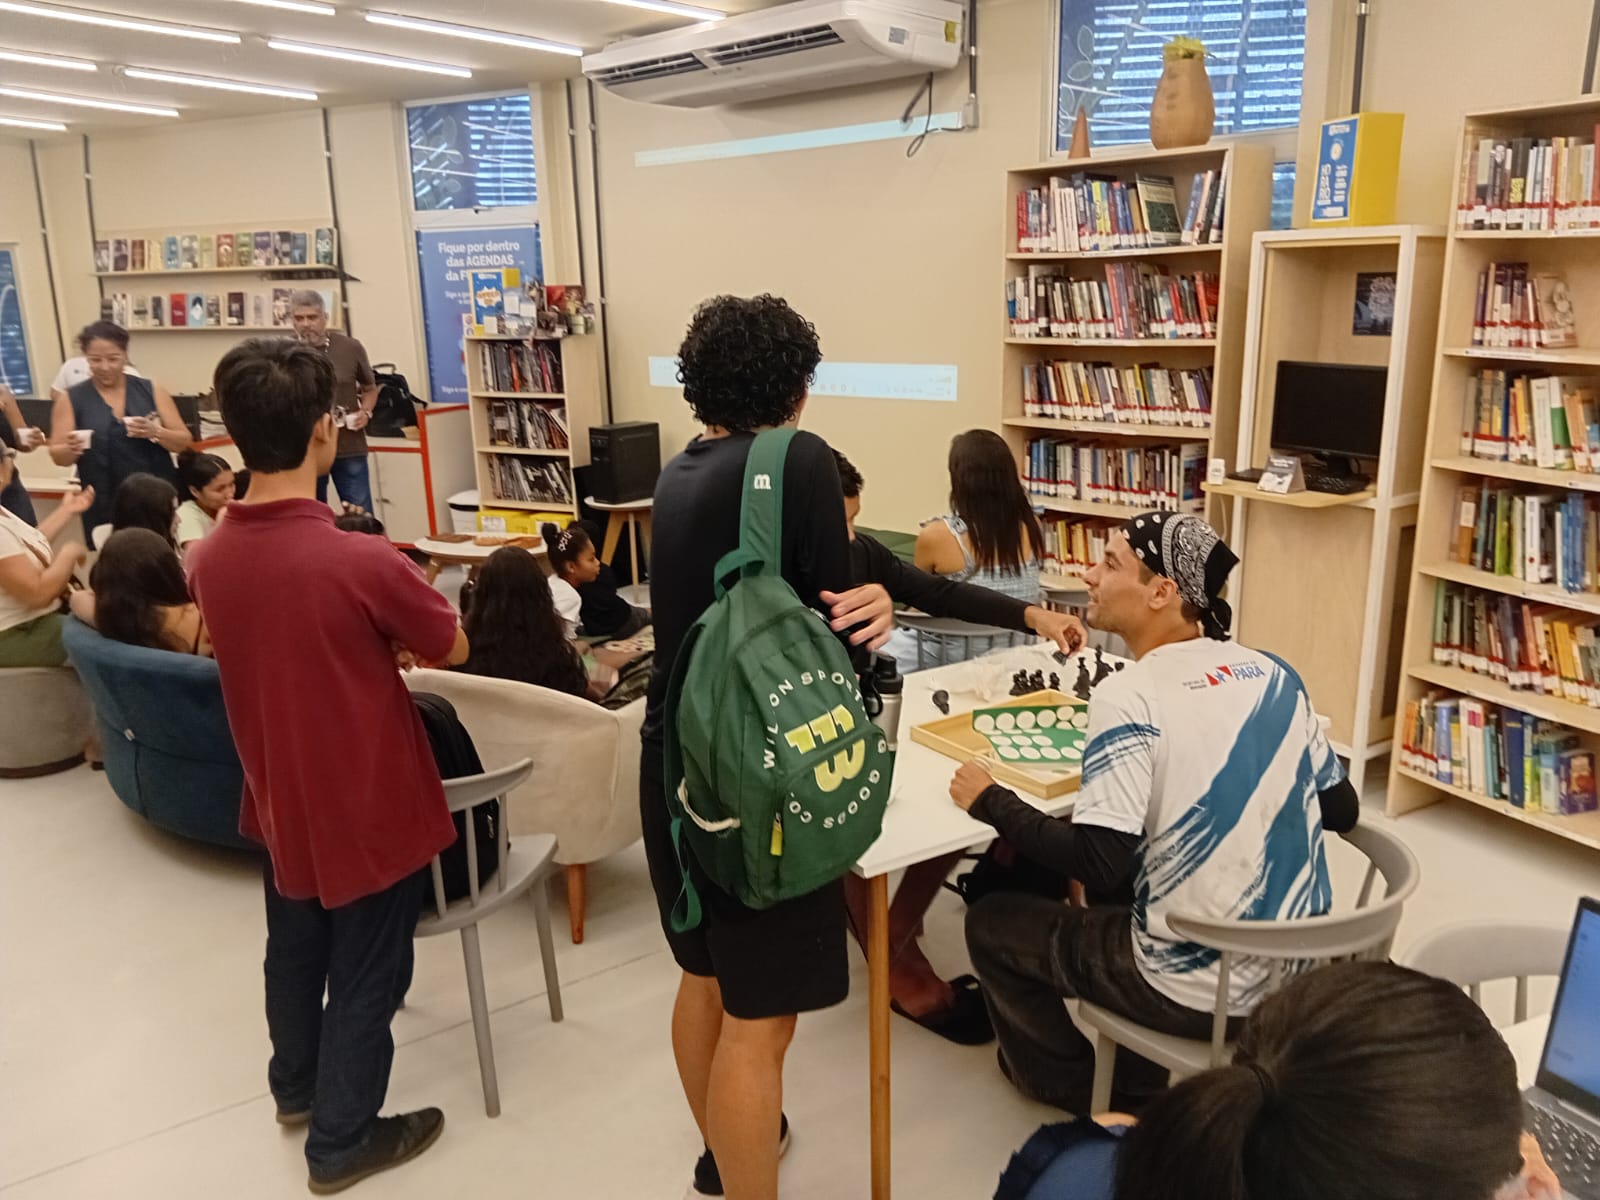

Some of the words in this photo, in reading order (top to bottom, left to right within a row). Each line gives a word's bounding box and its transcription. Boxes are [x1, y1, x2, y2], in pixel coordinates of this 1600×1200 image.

[438, 242, 466, 255] Fique
[467, 243, 484, 254] por
[485, 240, 520, 252] dentro
[446, 257, 465, 267] das
[466, 254, 514, 267] AGENDAS
[446, 270, 459, 281] da
[763, 679, 795, 769] WILON
